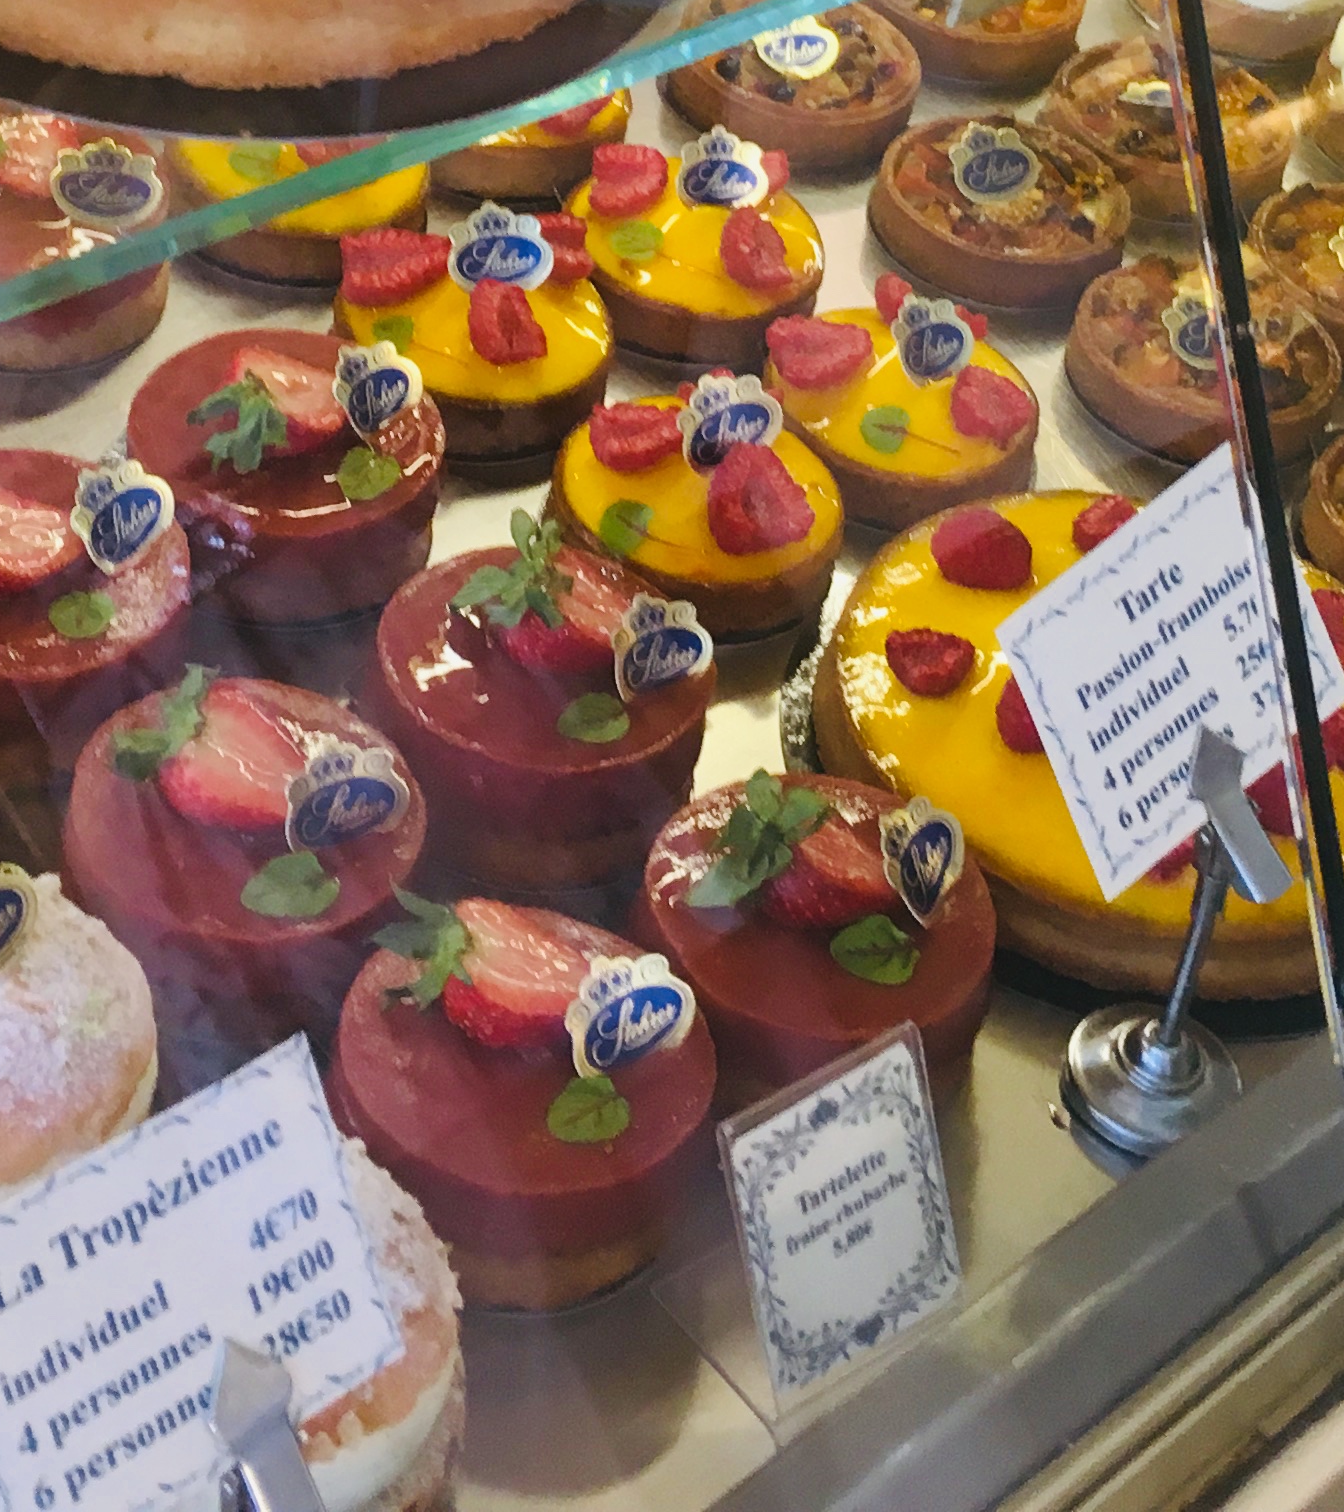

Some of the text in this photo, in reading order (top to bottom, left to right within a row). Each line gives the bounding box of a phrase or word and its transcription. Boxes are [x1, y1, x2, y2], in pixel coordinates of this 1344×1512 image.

[1076, 556, 1253, 712] Passion-framboise
[1113, 562, 1184, 625] Tarte
[1087, 654, 1191, 755] individuel
[1104, 765, 1117, 790] 4
[1120, 686, 1220, 786] personnes
[1118, 805, 1133, 830] 6
[1136, 722, 1235, 823] persos
[0, 1188, 318, 1406] individuel 4€70
[18, 1238, 334, 1453] 4 personnes 19€00
[33, 1289, 352, 1510] 6 personne 28€50
